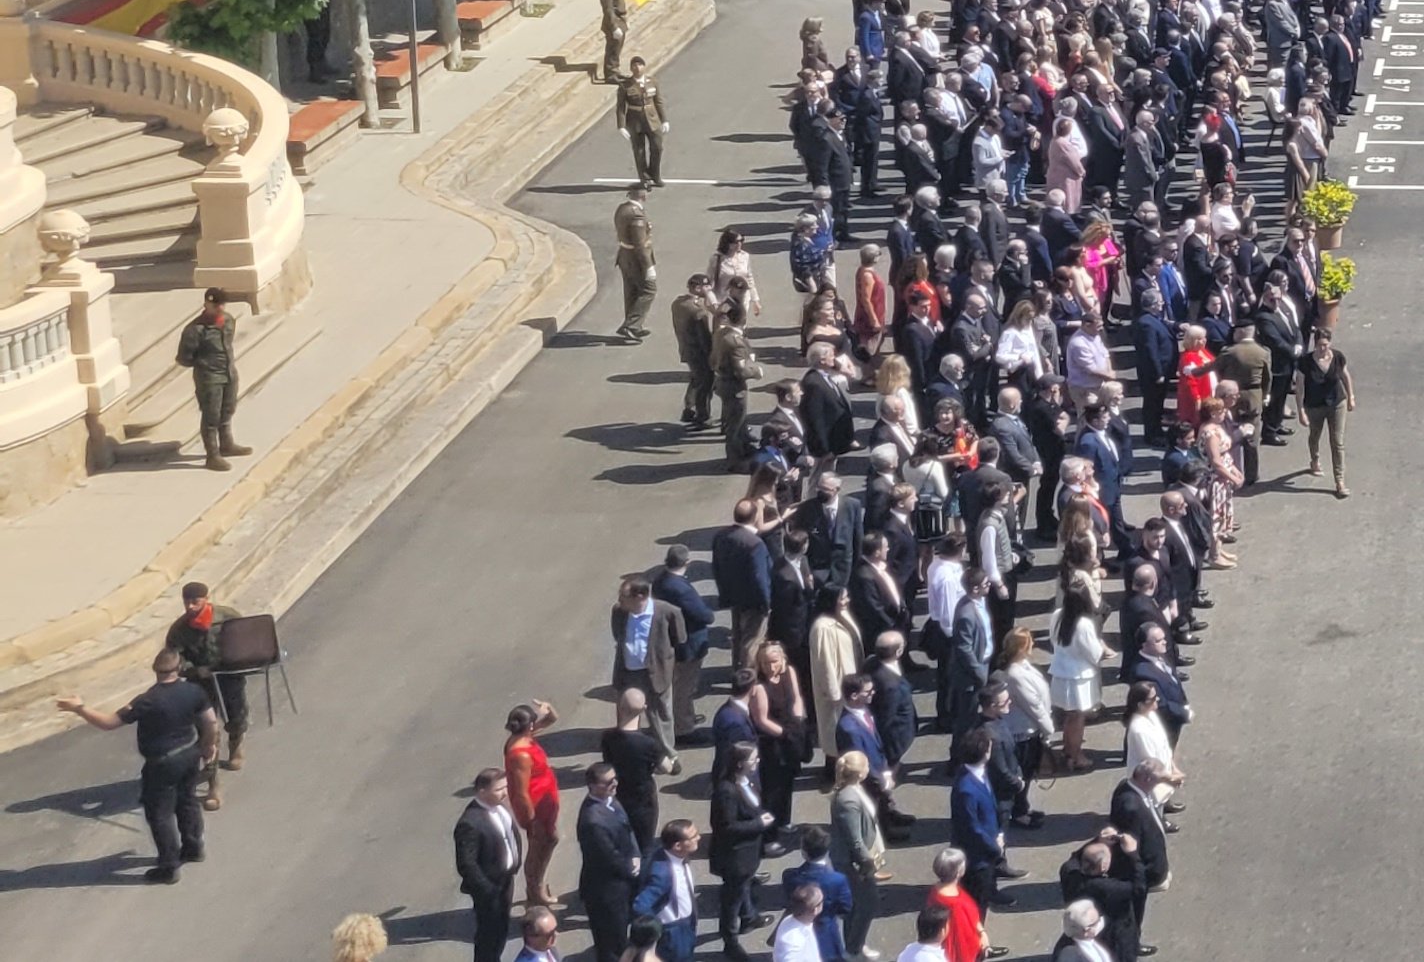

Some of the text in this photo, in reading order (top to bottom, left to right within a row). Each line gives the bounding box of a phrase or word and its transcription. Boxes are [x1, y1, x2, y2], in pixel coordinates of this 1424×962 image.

[1399, 13, 1424, 24] 89
[1390, 44, 1417, 56] 88
[1382, 79, 1411, 92] 87
[1373, 115, 1404, 130] 86
[1364, 157, 1396, 172] 85
